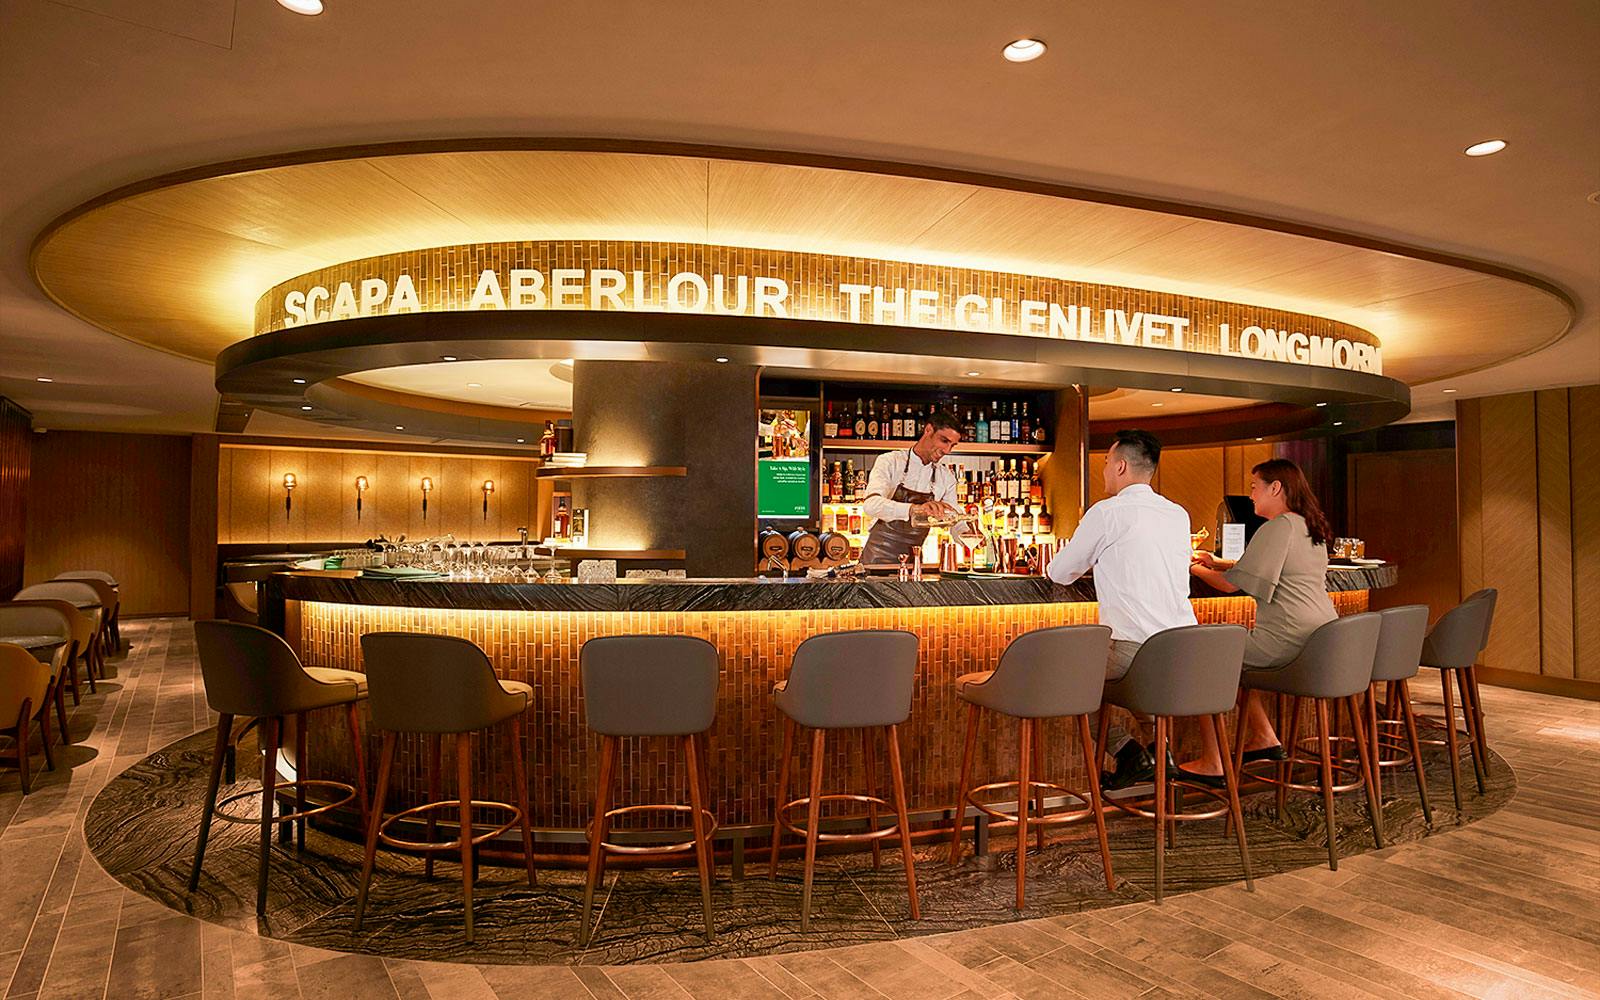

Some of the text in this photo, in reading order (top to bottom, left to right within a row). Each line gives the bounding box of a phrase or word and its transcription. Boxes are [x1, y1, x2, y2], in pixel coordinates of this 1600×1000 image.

[284, 274, 420, 328] SCAPA
[470, 268, 789, 317] ABERLOUR
[839, 283, 1190, 350] THE GLENLIVET
[1219, 323, 1383, 376] LONGMORN
